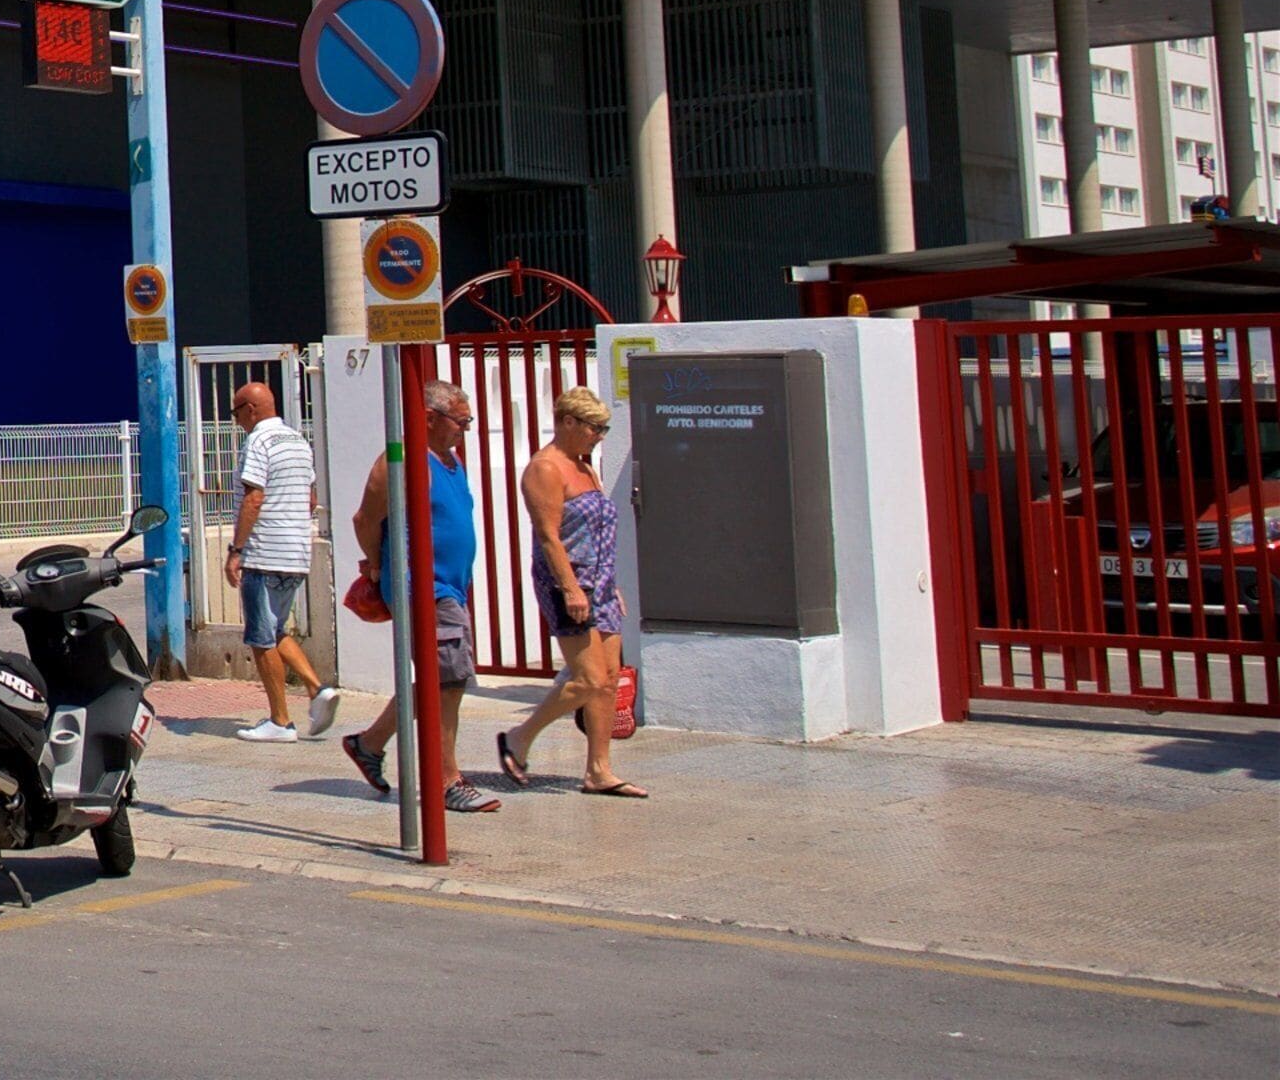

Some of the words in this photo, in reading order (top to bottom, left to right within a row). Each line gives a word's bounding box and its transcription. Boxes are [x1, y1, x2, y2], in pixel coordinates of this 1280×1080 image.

[317, 146, 430, 175] EXCEPTO
[331, 178, 418, 204] MOTOS
[379, 259, 421, 267] PERMANENTE
[655, 404, 712, 415] PROHIBIDO
[713, 404, 764, 415] CARTELES
[667, 418, 695, 428] AYTO.
[697, 418, 753, 429] BENIDORM
